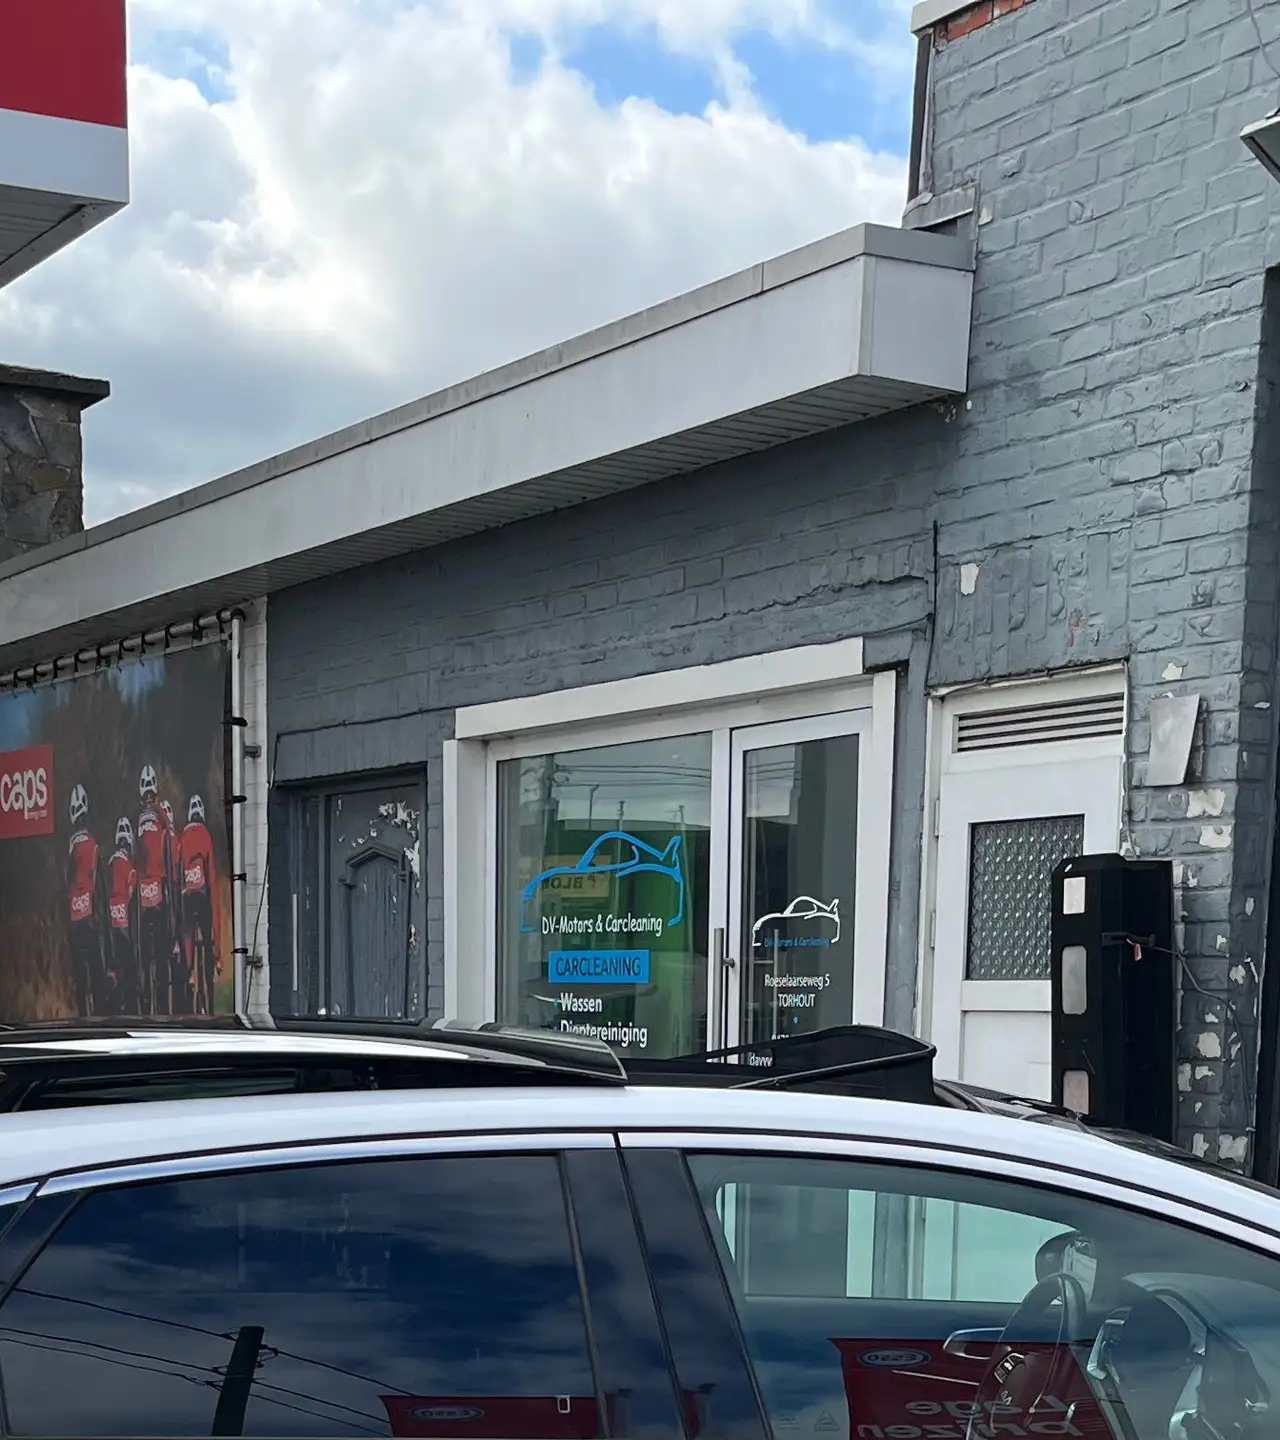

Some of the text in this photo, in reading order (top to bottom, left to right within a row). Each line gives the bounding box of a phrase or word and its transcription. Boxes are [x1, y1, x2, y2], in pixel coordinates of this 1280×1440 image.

[0, 767, 48, 820] caps
[542, 912, 663, 937] DV-Motors & Carcleaning
[555, 956, 642, 977] CARCLEANING
[764, 973, 830, 990] Roeselaarseweg 5
[560, 992, 602, 1012] Wassen
[778, 993, 816, 1008] TORHOUT
